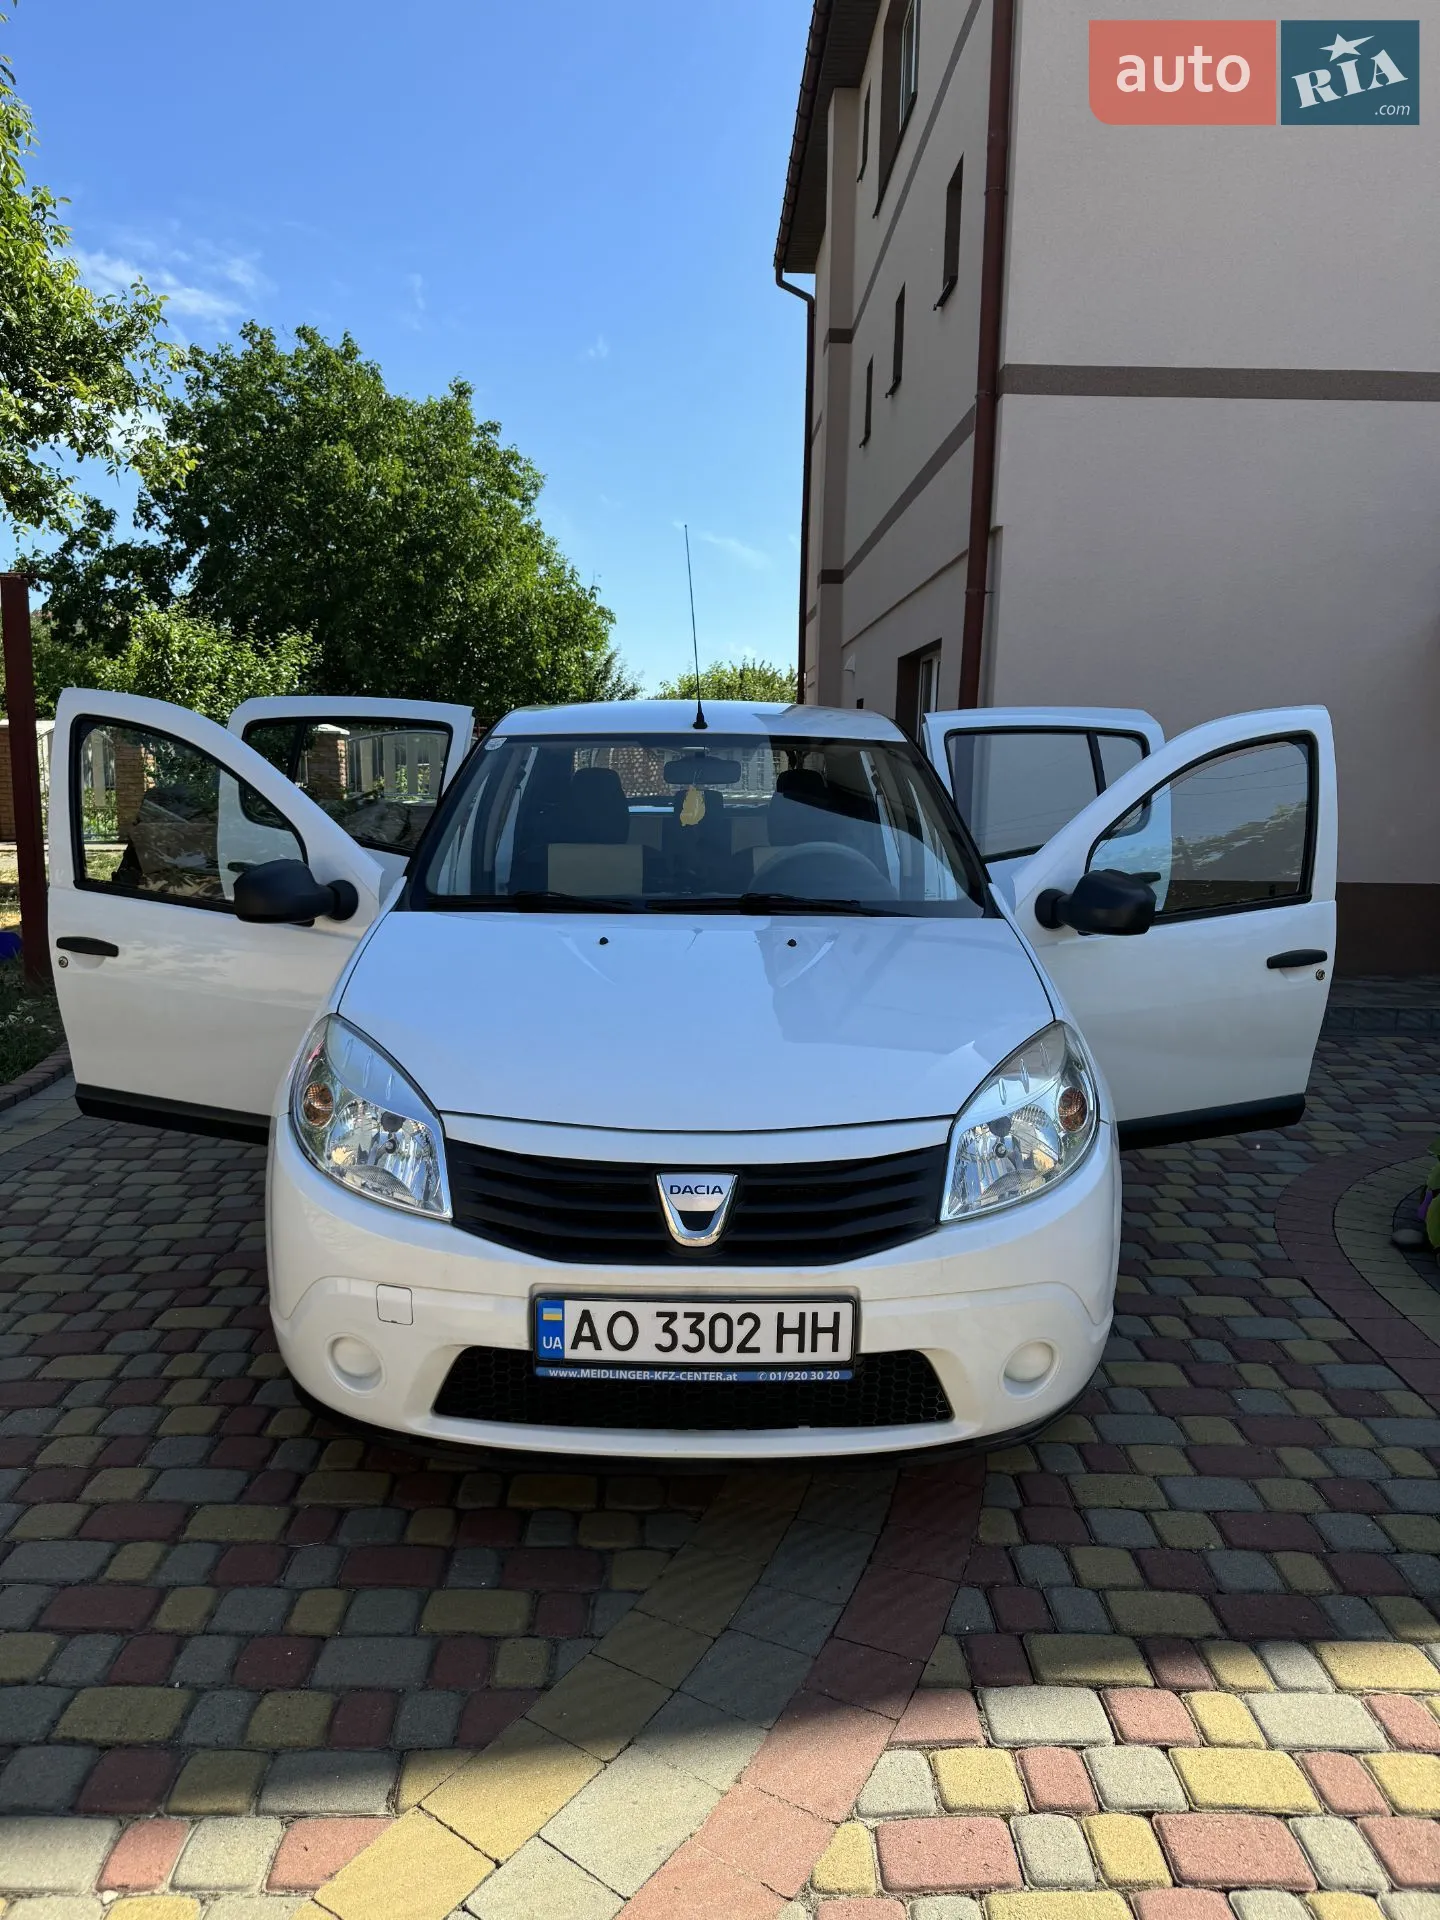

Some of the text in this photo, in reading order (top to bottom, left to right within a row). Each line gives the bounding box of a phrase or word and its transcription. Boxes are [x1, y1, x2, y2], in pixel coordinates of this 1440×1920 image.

[669, 1184, 724, 1195] DACIA
[570, 1309, 841, 1354] AO 3302 HH
[542, 1336, 563, 1350] UA
[549, 1368, 840, 1381] www.MEIDLINGER-KFZ-CENTER.at 01/920 30 20
